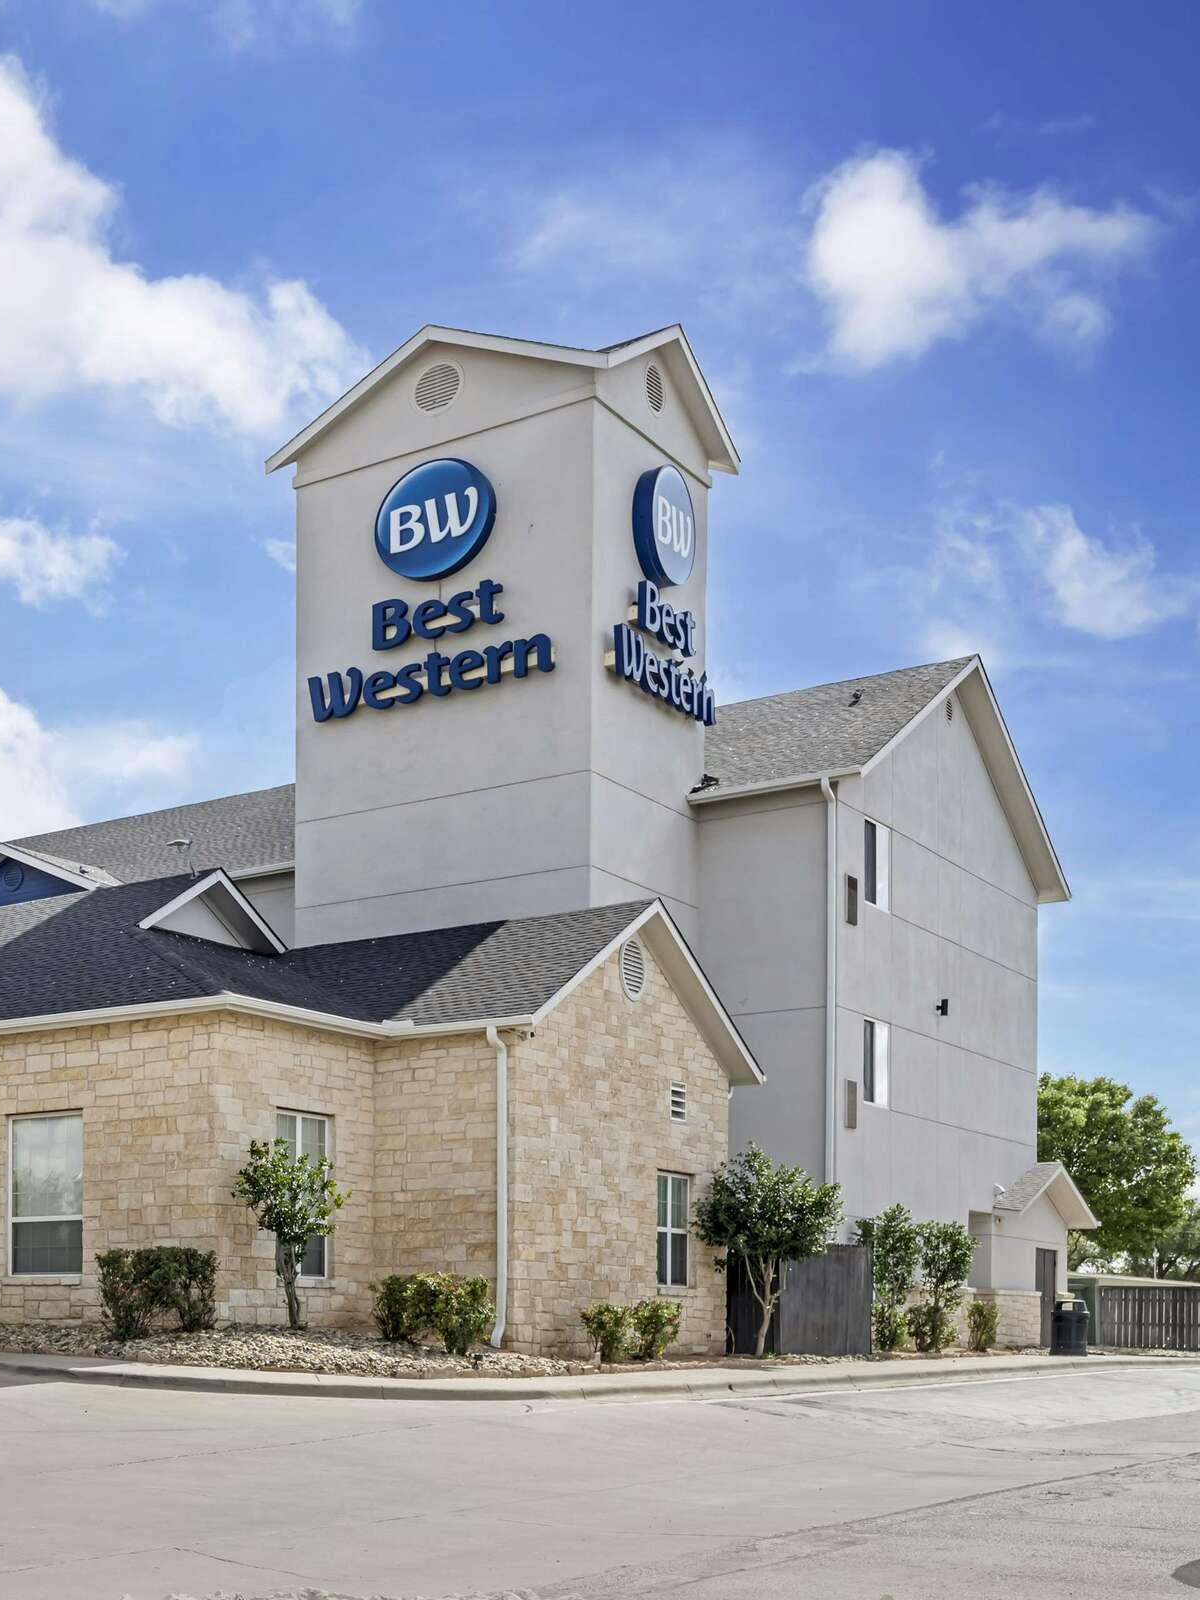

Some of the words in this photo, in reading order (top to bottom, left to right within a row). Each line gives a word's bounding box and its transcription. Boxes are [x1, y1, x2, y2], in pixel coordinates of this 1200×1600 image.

[389, 486, 479, 554] BW
[657, 495, 692, 558] BW
[372, 579, 505, 651] Best
[638, 580, 696, 657] Best
[307, 633, 556, 723] Western
[614, 623, 716, 726] Western
